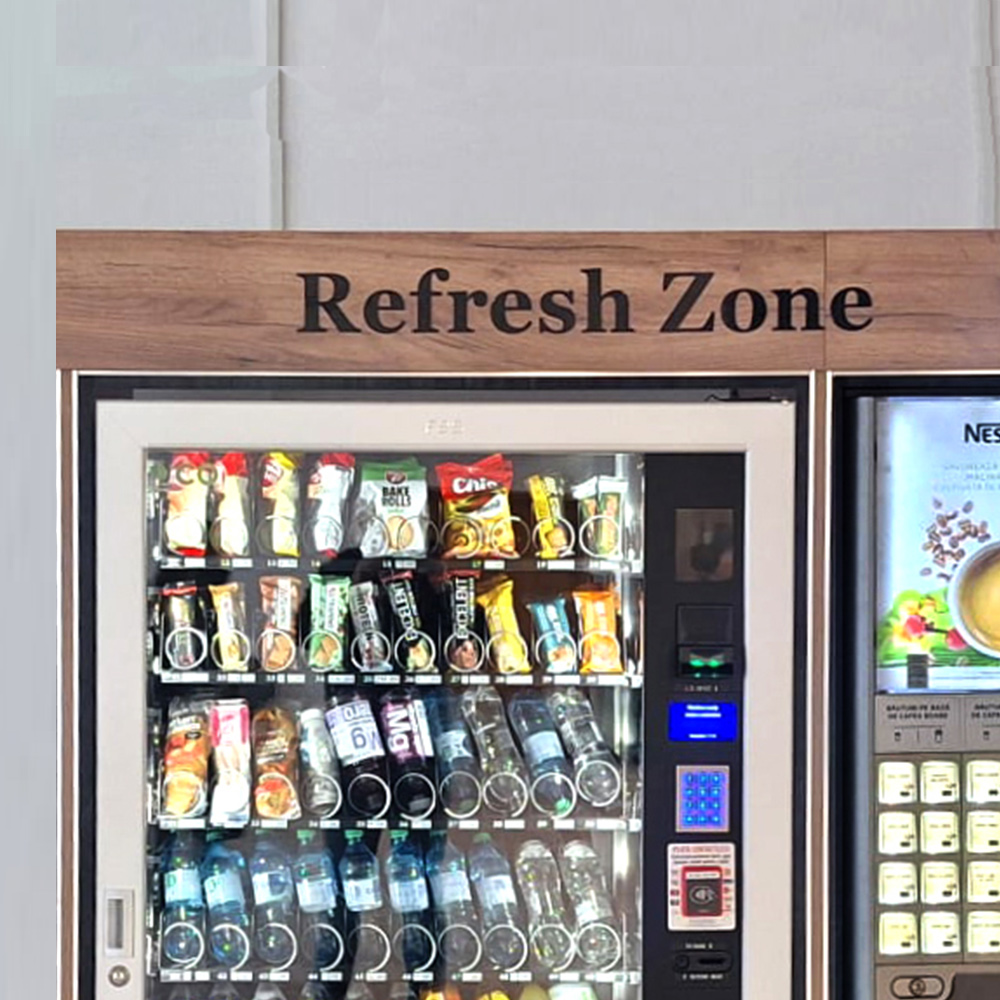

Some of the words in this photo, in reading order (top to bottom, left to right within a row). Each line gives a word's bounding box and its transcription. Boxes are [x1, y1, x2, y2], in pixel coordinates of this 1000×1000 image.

[296, 267, 635, 335] Refresh
[659, 271, 876, 334] Zone
[386, 708, 412, 754] Mg
